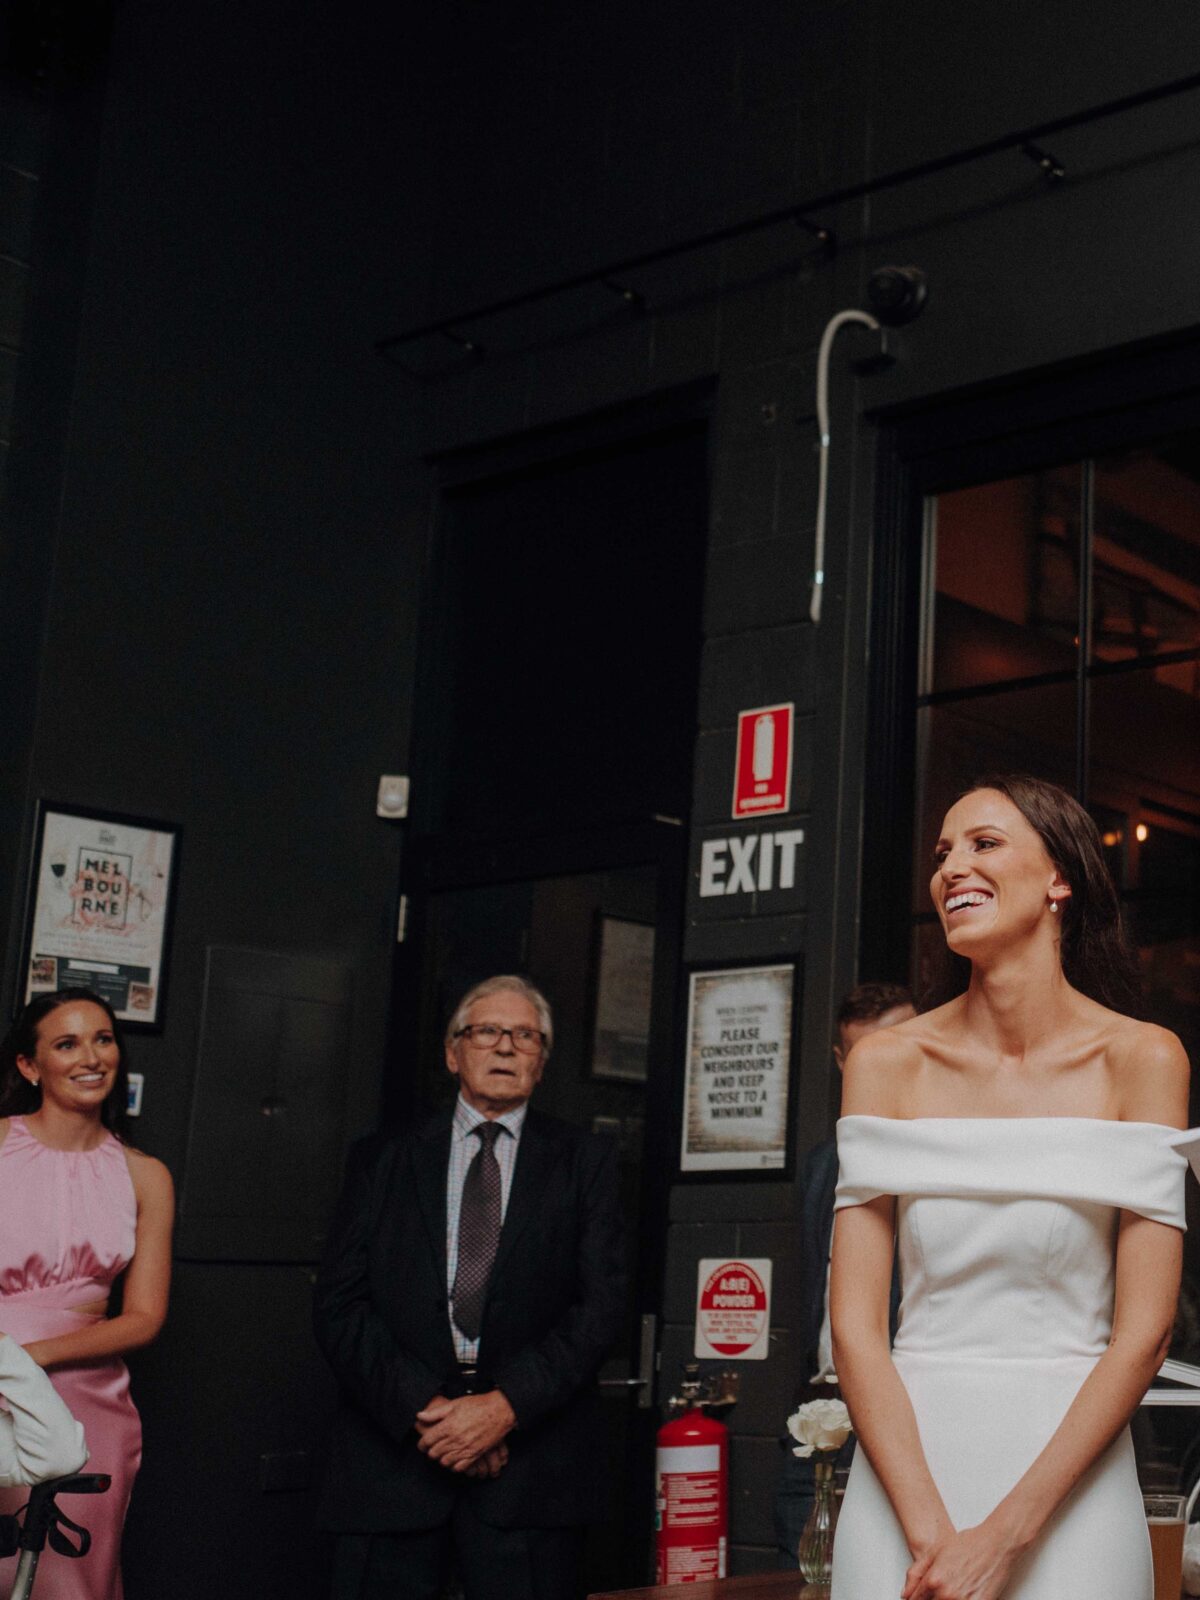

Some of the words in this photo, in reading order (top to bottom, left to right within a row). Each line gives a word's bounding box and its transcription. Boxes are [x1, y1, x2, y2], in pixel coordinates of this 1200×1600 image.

[86, 858, 122, 876] MEL
[699, 829, 804, 898] EXIT
[84, 877, 122, 895] BOU
[81, 897, 119, 916] RNE
[721, 1027, 760, 1041] PLEASE
[700, 1043, 753, 1058] CONSIDER
[756, 1041, 779, 1056] OUR
[703, 1058, 774, 1073] NEIGHBOURS
[713, 1076, 735, 1088] AND
[738, 1074, 765, 1087] KEEP
[707, 1091, 740, 1104] NOISE
[744, 1090, 758, 1103] TO
[760, 1089, 768, 1102] A
[710, 1106, 763, 1119] MINIMUM
[712, 1294, 756, 1308] POWDER
